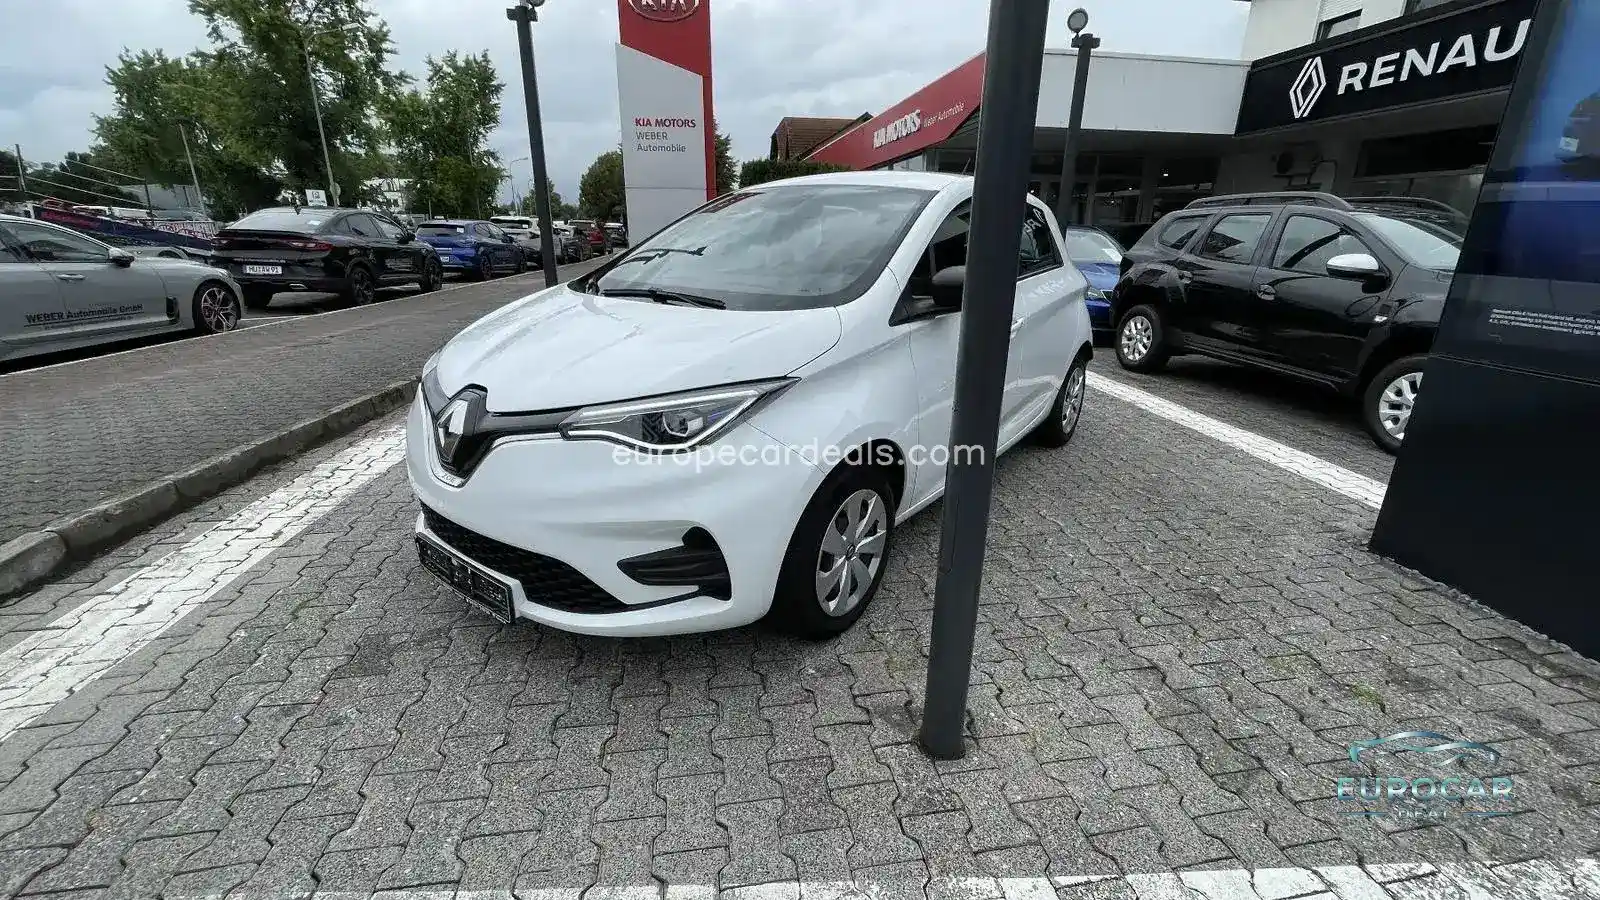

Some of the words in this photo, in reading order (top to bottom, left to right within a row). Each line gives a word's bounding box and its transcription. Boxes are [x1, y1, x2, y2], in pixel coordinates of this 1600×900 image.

[1337, 19, 1532, 95] RENAU
[634, 117, 653, 128] KIA
[655, 118, 697, 129] MOTORS
[886, 109, 921, 143] MOTORS
[636, 131, 668, 141] WEBER
[637, 143, 687, 153] Automobile
[25, 311, 65, 324] WEBER
[67, 306, 118, 319] Automobile
[119, 303, 143, 313] GmbH
